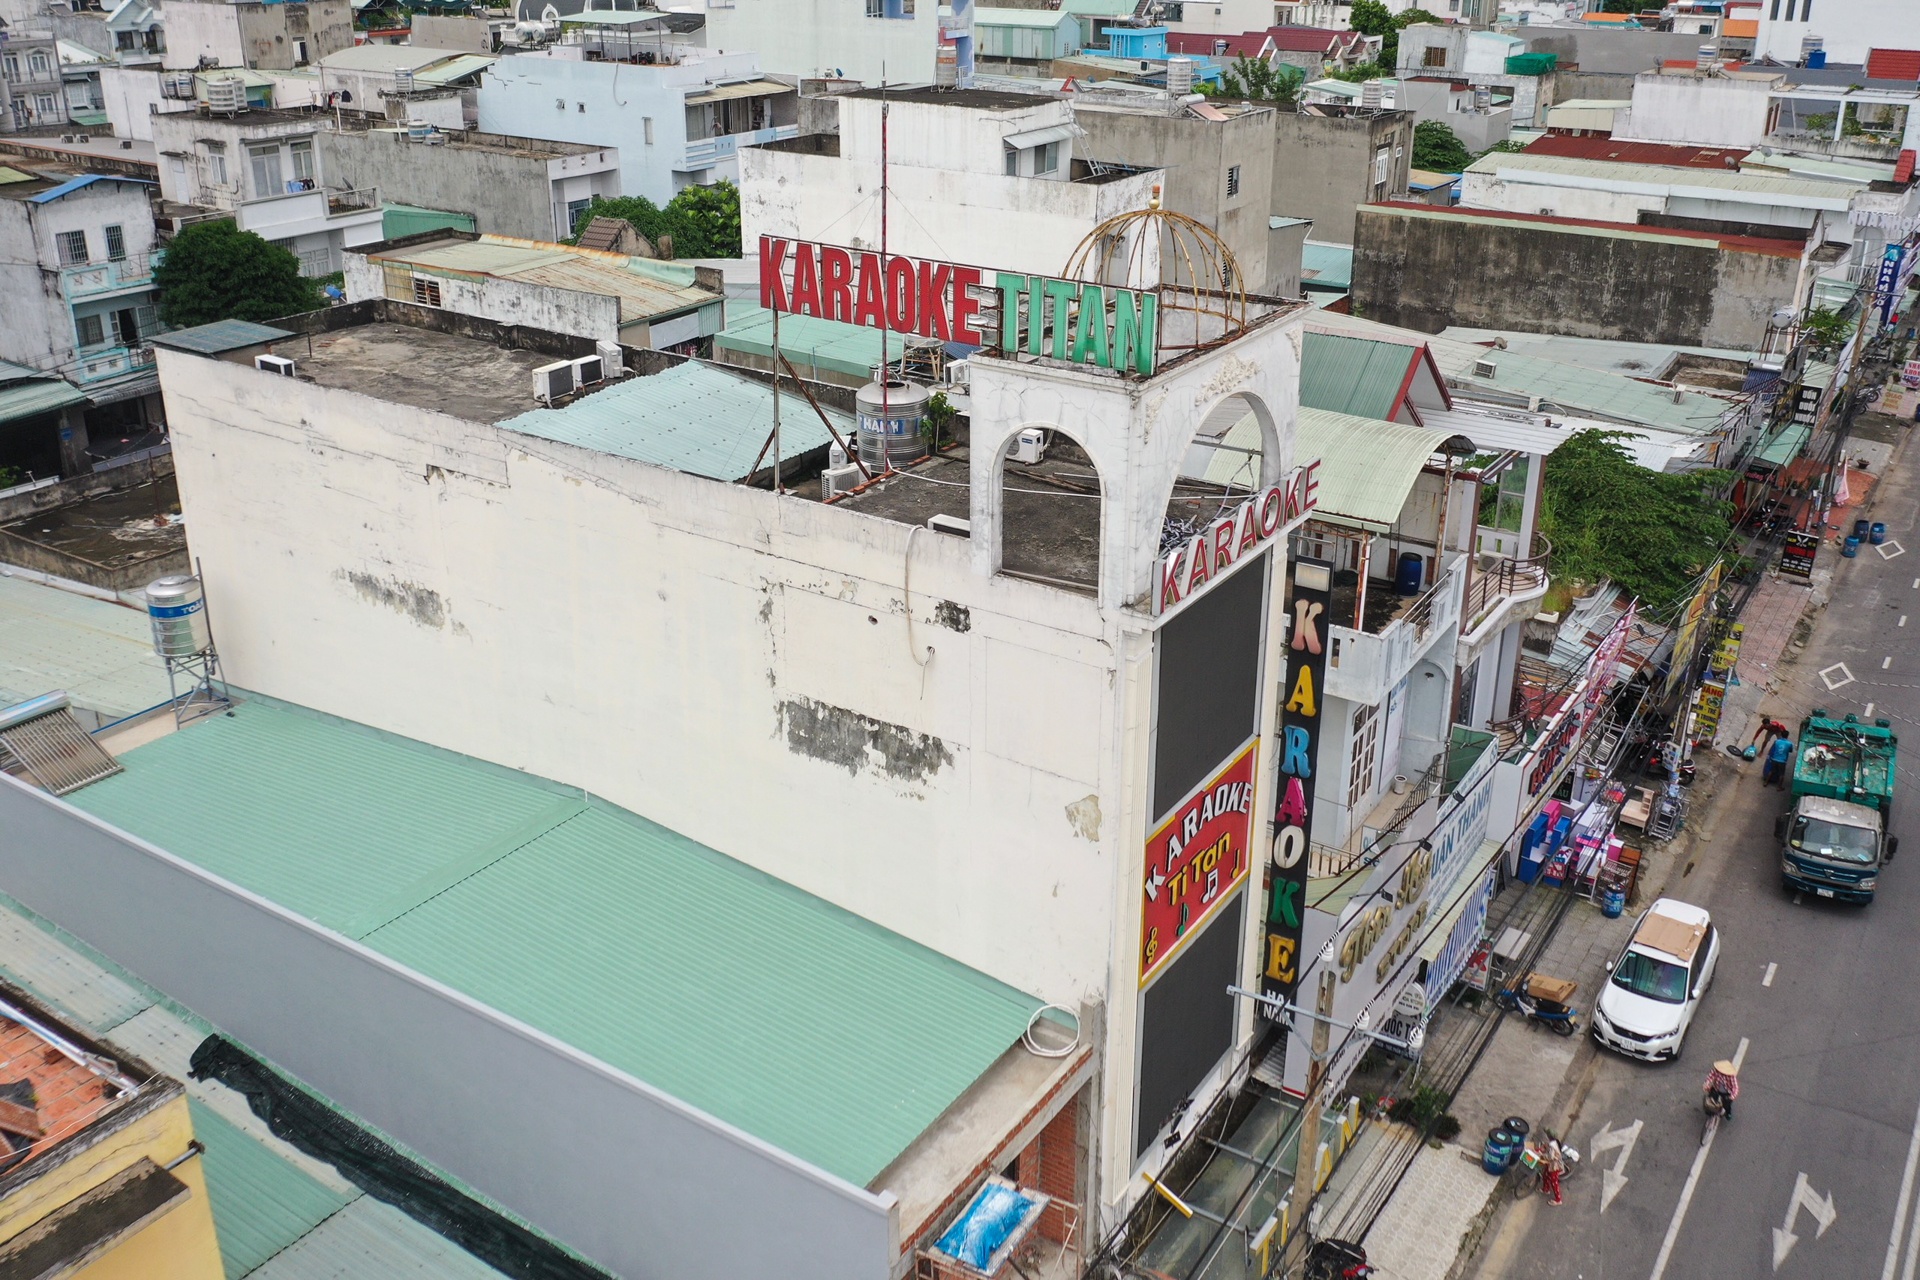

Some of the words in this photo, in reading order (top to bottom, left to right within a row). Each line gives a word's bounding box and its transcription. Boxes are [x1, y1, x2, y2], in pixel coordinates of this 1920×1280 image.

[759, 235, 984, 346] KARAOKE
[996, 272, 1158, 376] TITAN
[1157, 457, 1321, 614] KARAOKE
[1145, 782, 1253, 901] KARAOKE
[1265, 599, 1324, 984] KARAOKE
